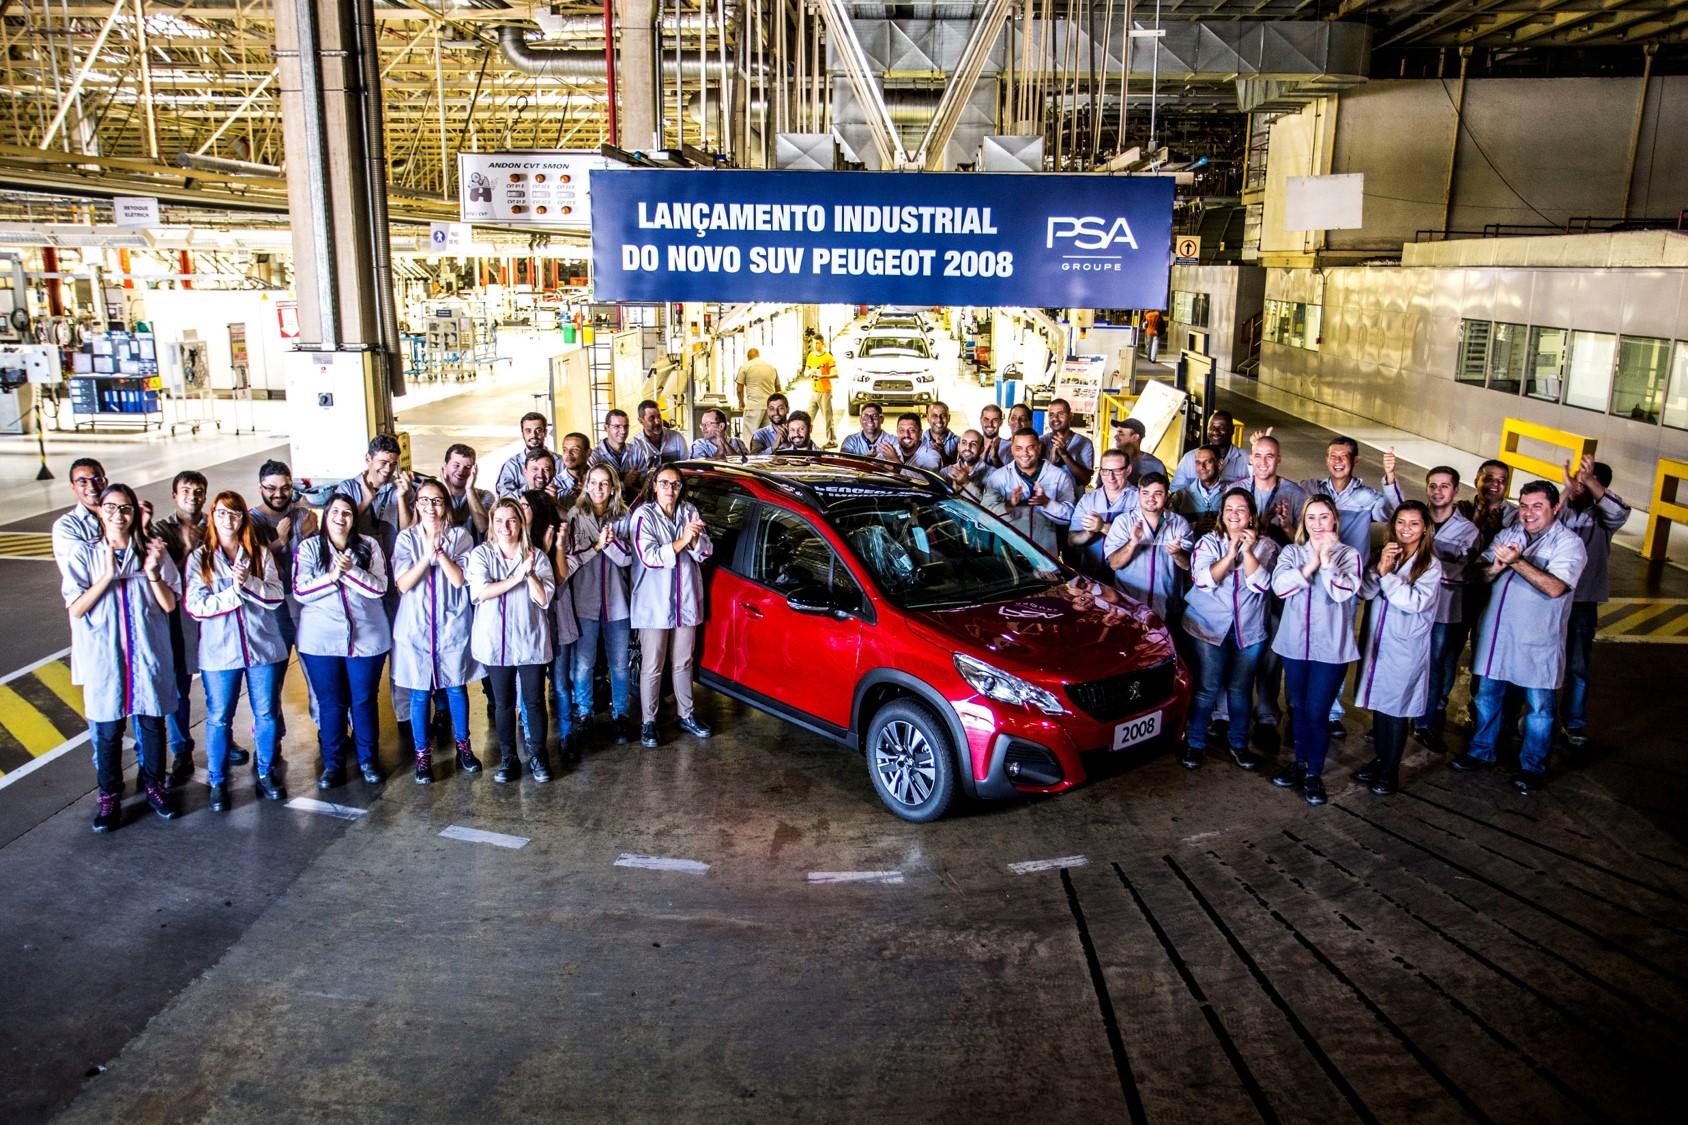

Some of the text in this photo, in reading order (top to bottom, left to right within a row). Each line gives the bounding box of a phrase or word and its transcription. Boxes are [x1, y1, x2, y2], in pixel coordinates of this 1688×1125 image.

[639, 202, 998, 238] LANÇAMENTO INDUSTRIAL
[1046, 216, 1139, 250] PSA
[621, 244, 1014, 278] DO NOVO SUV PEUGEOT 2008
[1062, 262, 1122, 272] GROUPE
[1121, 716, 1156, 744] 2008
